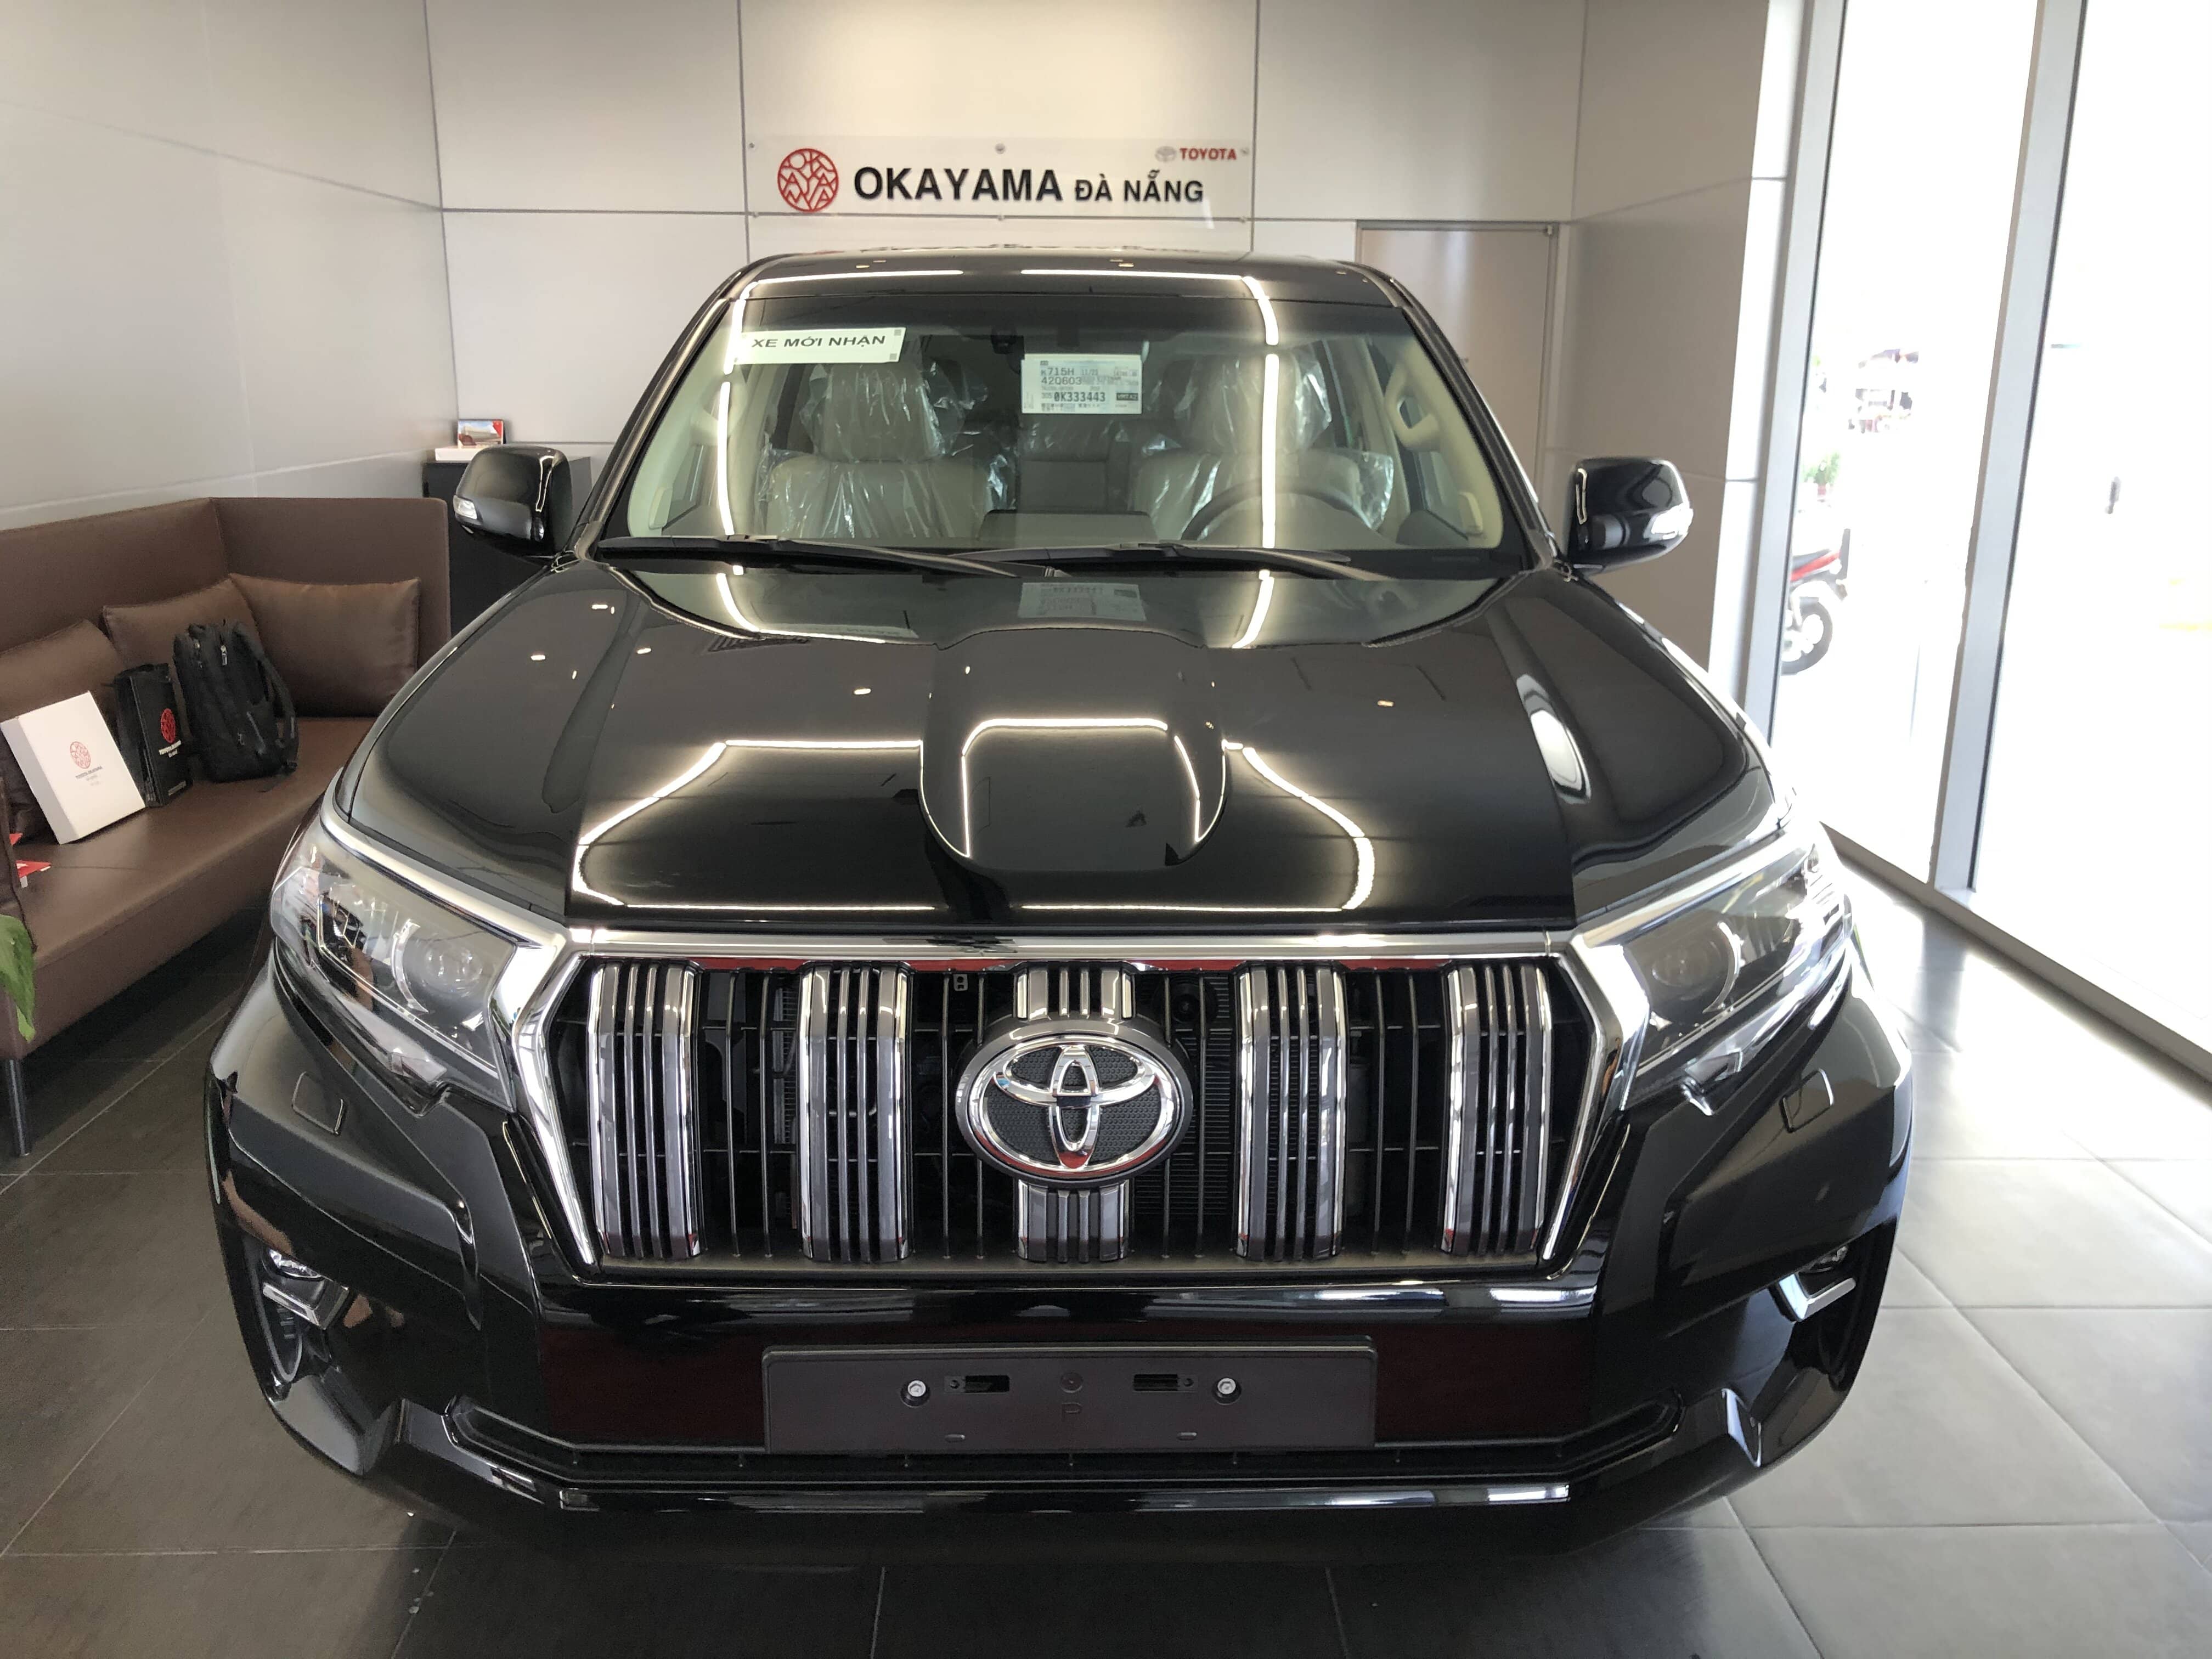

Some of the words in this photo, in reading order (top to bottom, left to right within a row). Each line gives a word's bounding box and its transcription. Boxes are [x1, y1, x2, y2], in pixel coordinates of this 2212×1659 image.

[1180, 148, 1237, 160] TOYOTA
[854, 167, 1063, 201] OKAYAMA
[1075, 173, 1113, 202] ĐÀ
[1124, 169, 1203, 202] NẴNG
[752, 338, 778, 347] XE
[784, 336, 822, 347] MỚI
